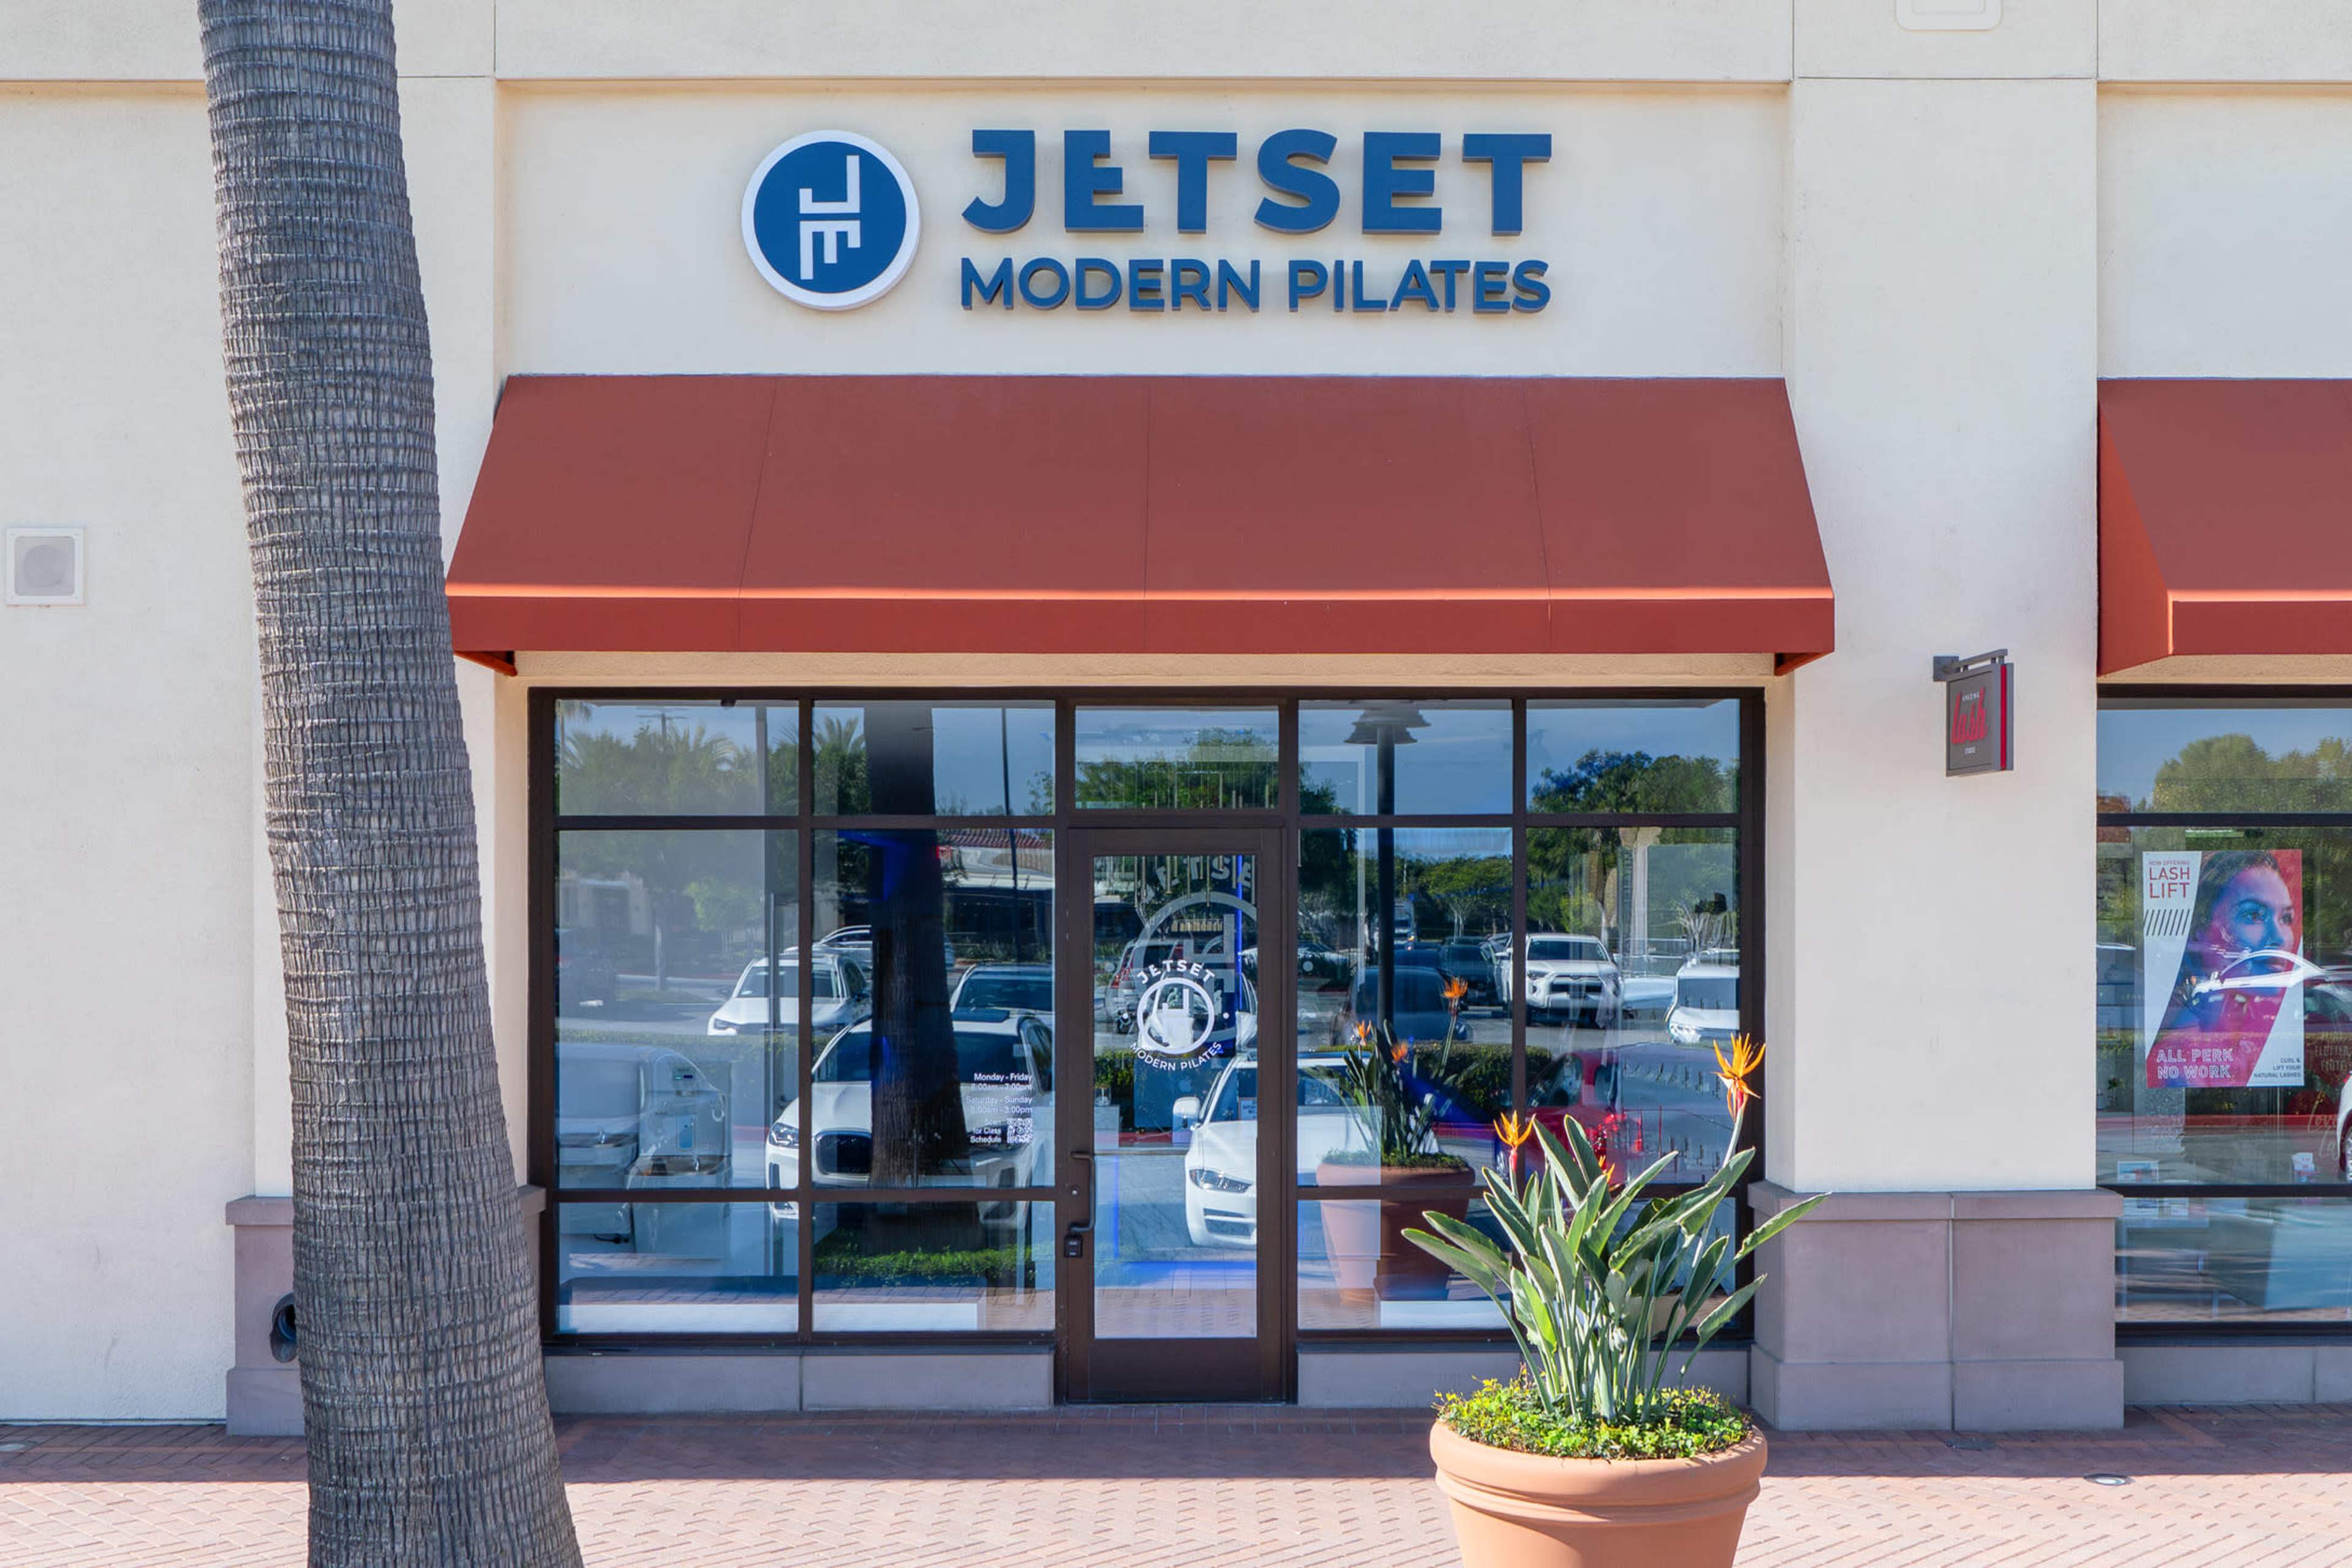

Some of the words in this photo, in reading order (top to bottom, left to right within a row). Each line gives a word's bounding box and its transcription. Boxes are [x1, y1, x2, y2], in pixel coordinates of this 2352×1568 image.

[961, 129, 1552, 236] JETSET
[961, 257, 1261, 312] MODERN
[1288, 260, 1551, 314] PILATES
[2149, 867, 2190, 880] LASH
[2149, 882, 2190, 899] LIFT
[1136, 959, 1215, 984] JETSET
[1129, 1041, 1177, 1071] MODERN
[1180, 1041, 1223, 1071] PILATES
[2156, 1049, 2186, 1062] ALL
[2191, 1048, 2233, 1061] PERK
[974, 1073, 1005, 1082] Monday
[1010, 1073, 1033, 1082] Friday
[2157, 1065, 2179, 1079] NO
[2184, 1065, 2231, 1079] WORK
[966, 1096, 998, 1104] Saturday
[1005, 1096, 1033, 1104] Sunday
[984, 1126, 1001, 1135] Class
[970, 1136, 1002, 1145] Schedule
